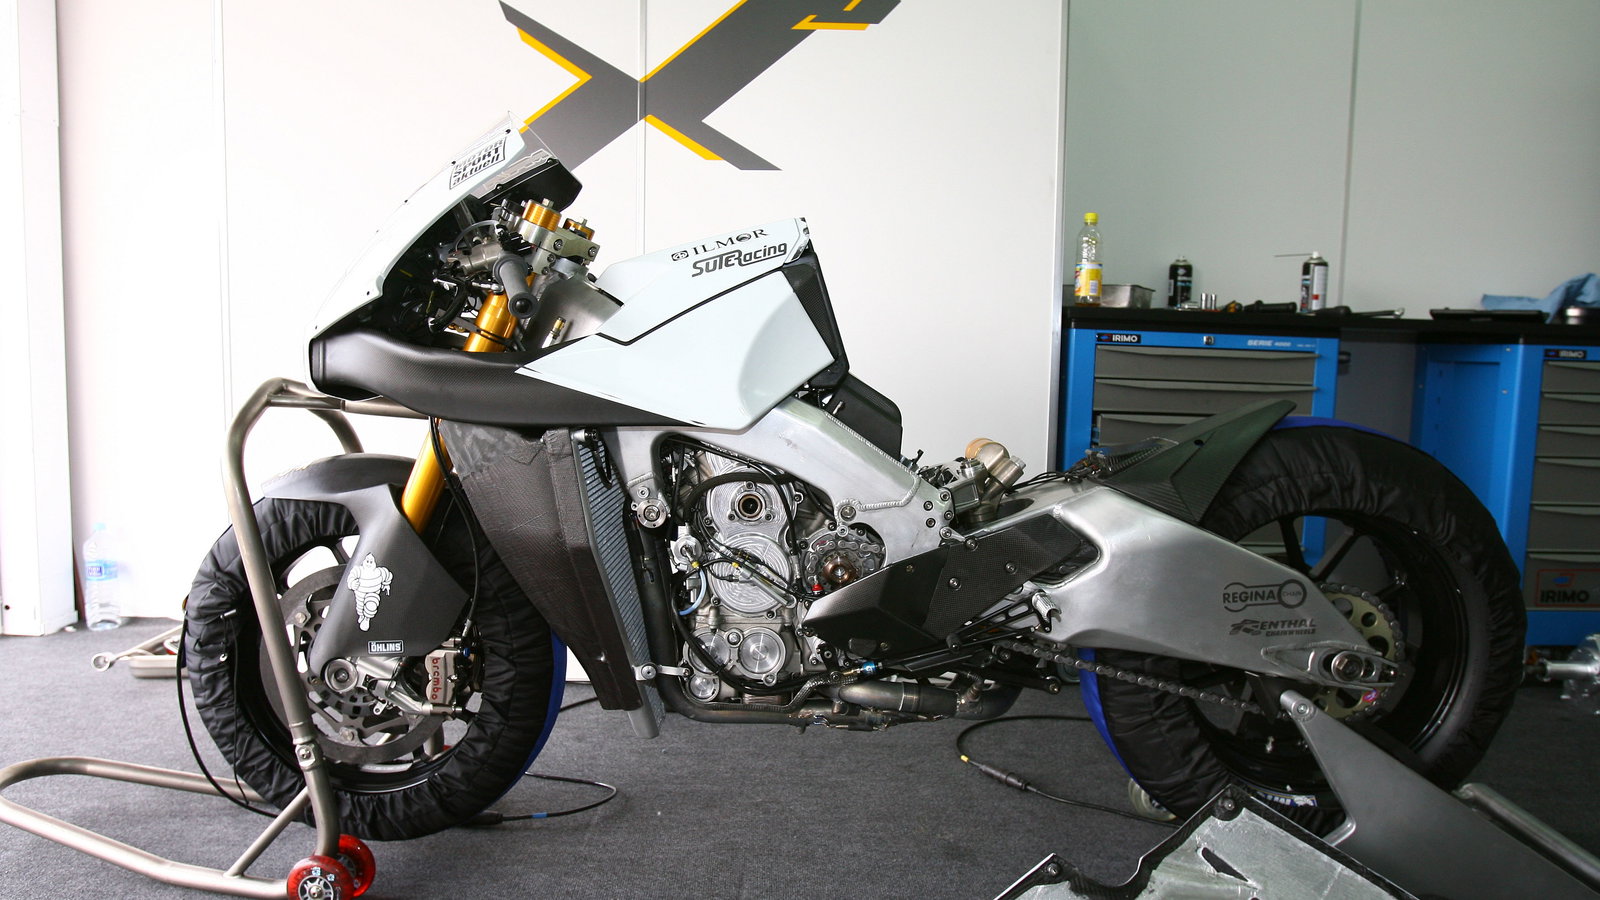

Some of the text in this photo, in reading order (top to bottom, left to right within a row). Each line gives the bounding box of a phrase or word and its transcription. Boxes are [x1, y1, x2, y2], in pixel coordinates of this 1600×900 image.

[453, 146, 499, 178] SPORT
[453, 153, 500, 186] aktuell
[691, 228, 769, 255] ILMOR
[1112, 334, 1138, 343] IRIMO
[1559, 350, 1585, 359] IRIMO
[1223, 590, 1276, 604] REGINA
[1540, 589, 1590, 603] IRIMO
[371, 643, 401, 652] ÖHLINS
[432, 657, 442, 700] brembo
